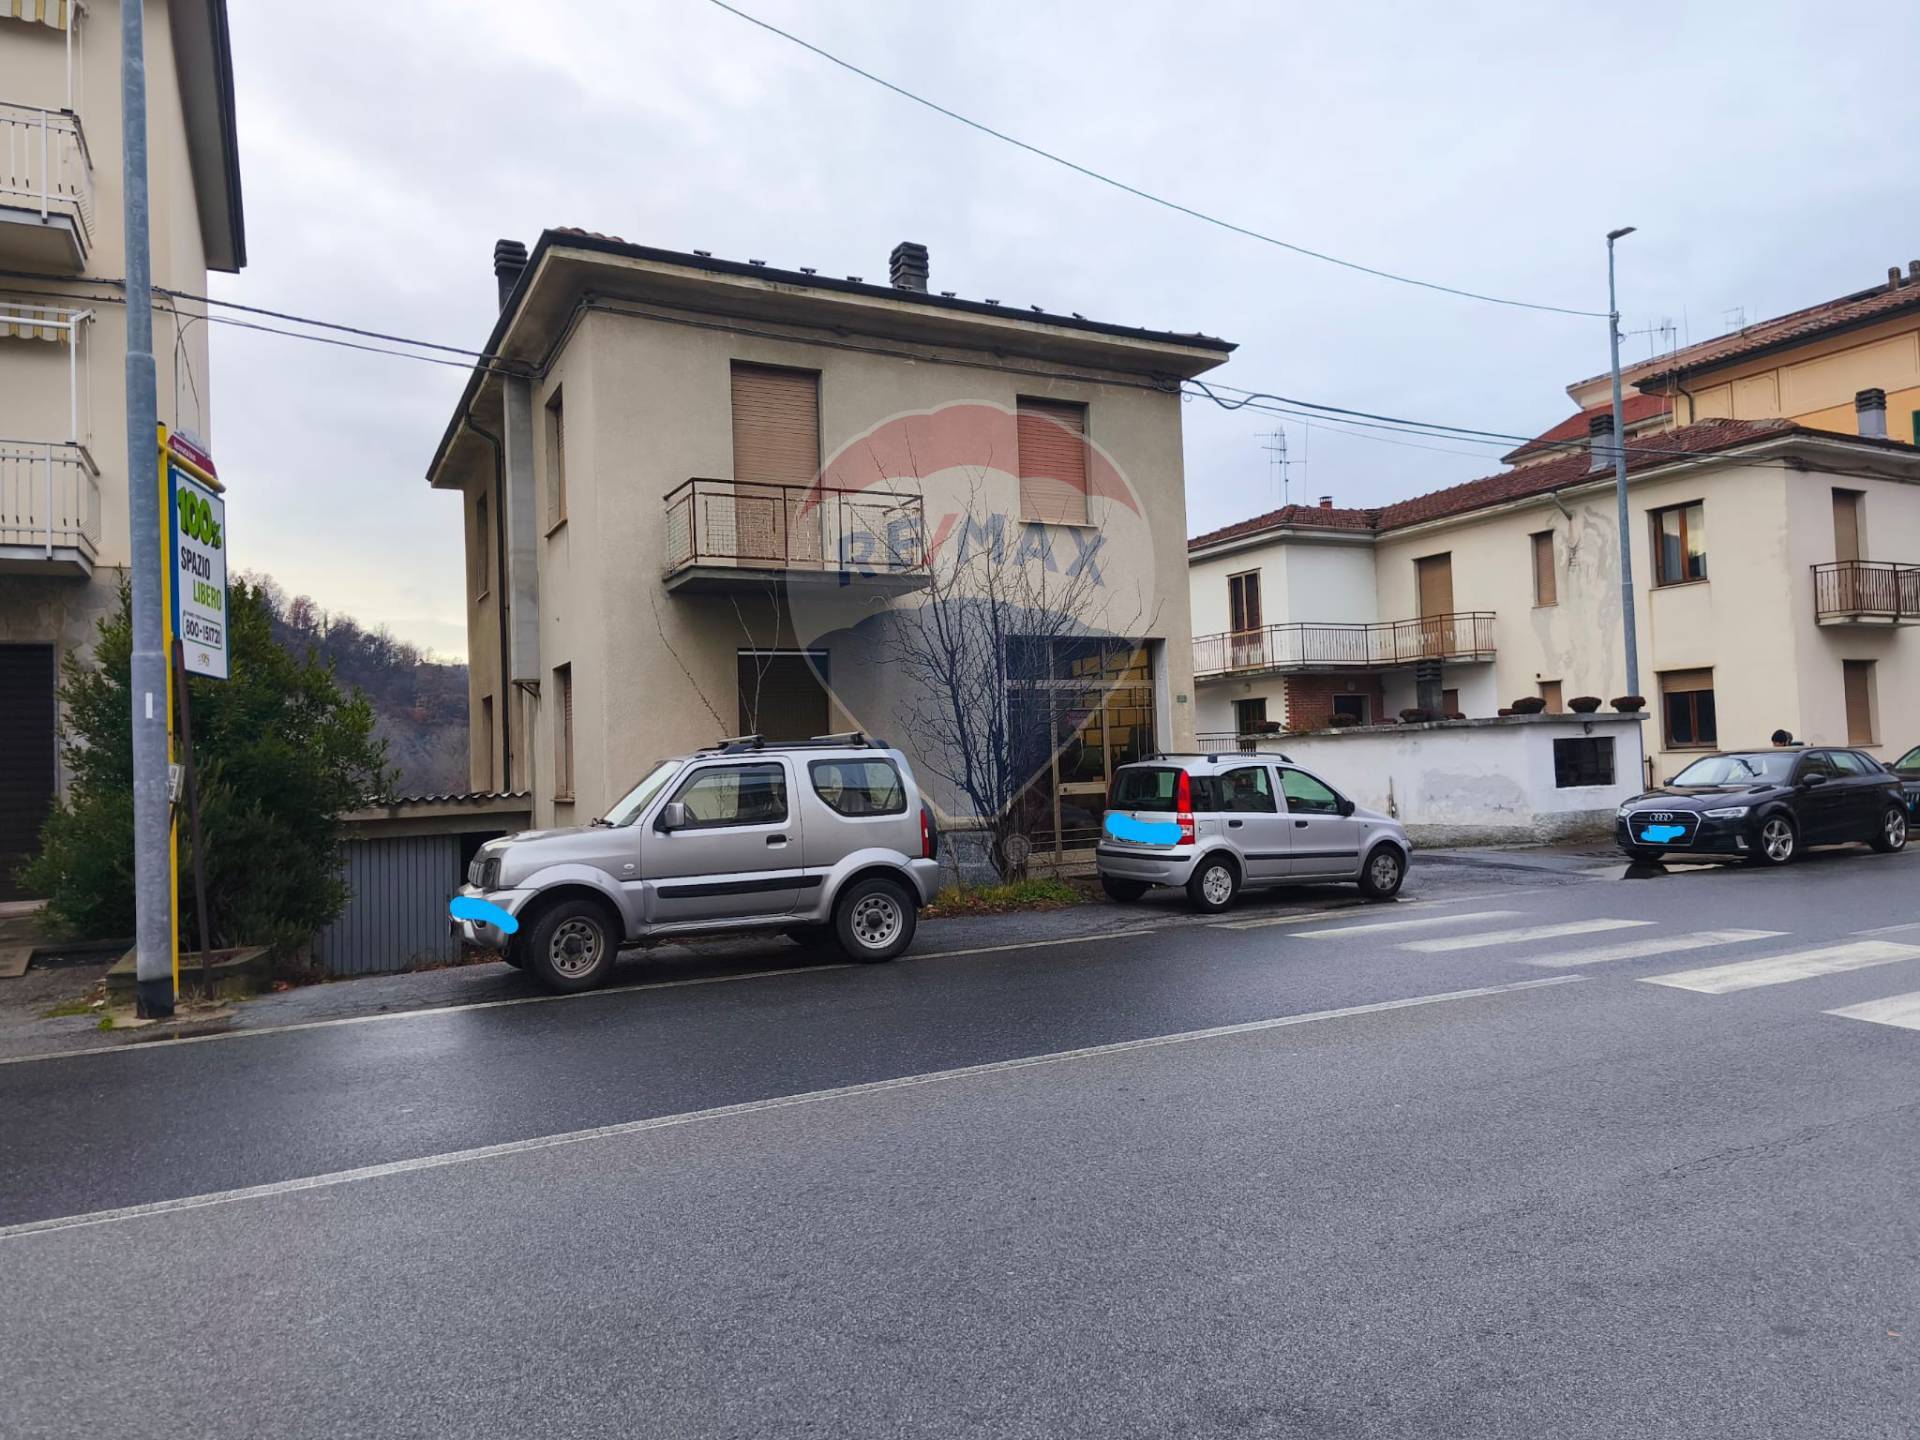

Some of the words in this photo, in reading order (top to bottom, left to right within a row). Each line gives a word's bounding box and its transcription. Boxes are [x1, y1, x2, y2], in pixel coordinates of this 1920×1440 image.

[178, 487, 222, 550] 100%
[181, 546, 210, 581] SPAZIO
[193, 580, 222, 611] LIBERO
